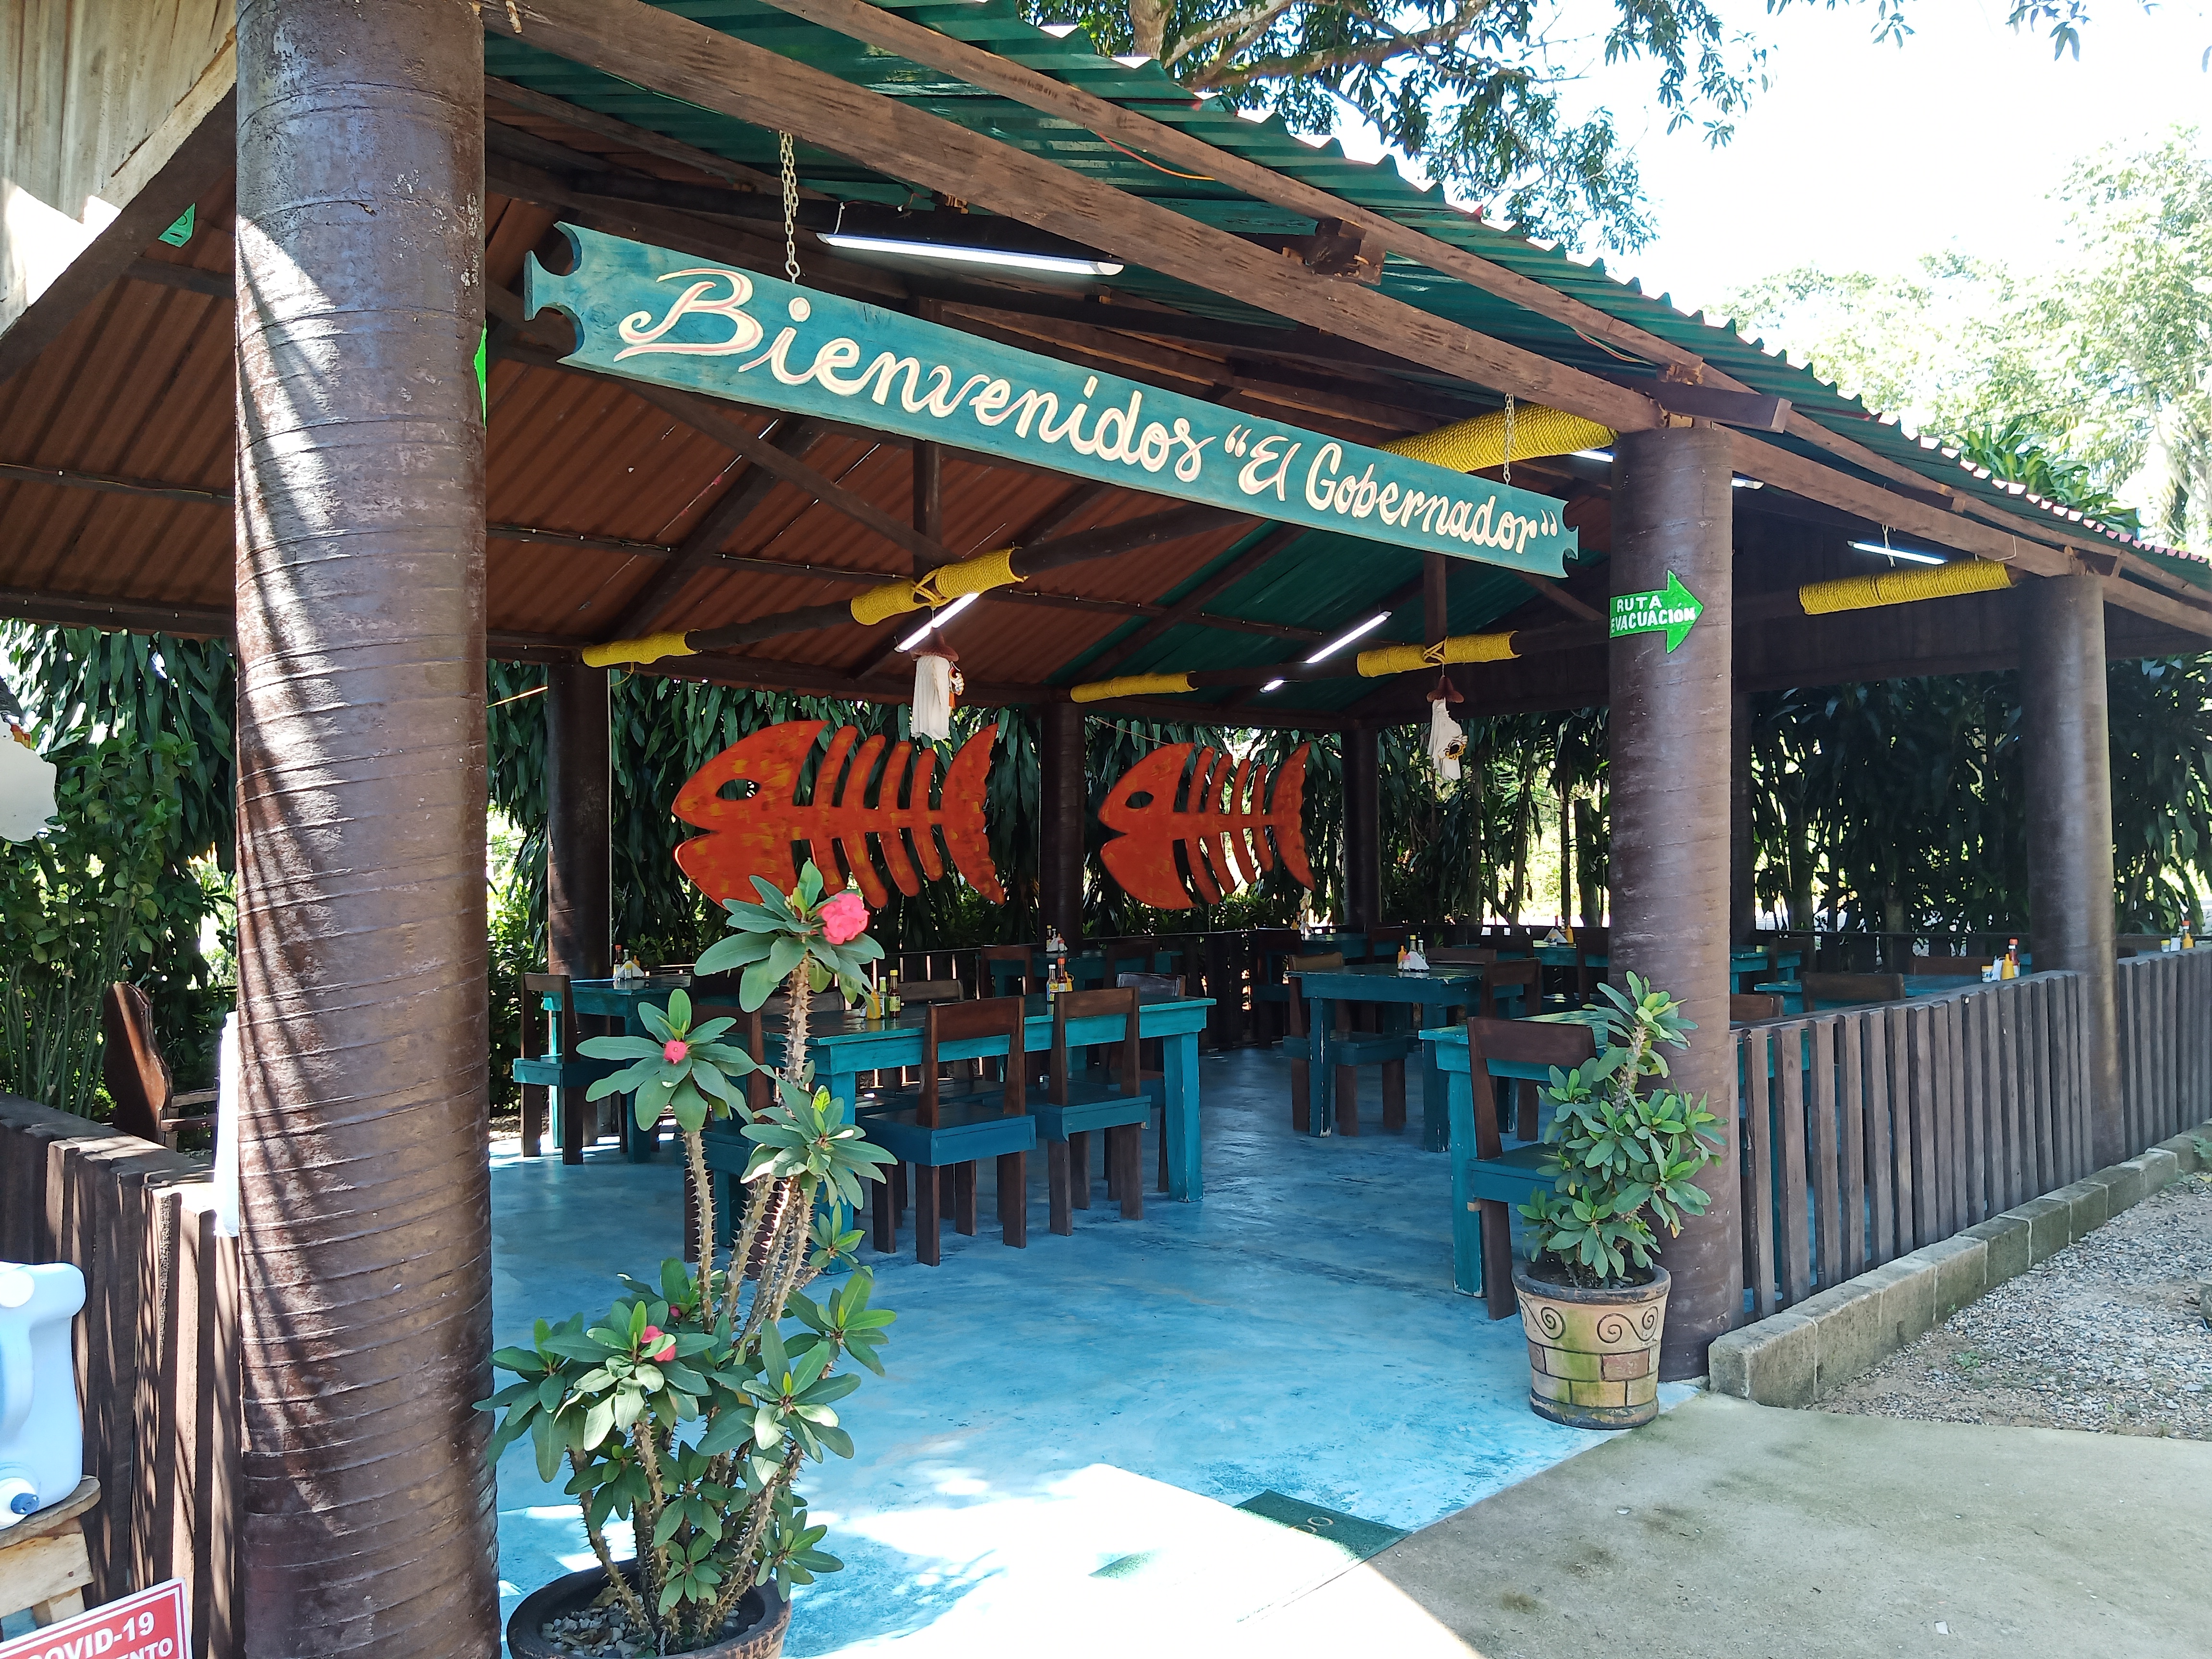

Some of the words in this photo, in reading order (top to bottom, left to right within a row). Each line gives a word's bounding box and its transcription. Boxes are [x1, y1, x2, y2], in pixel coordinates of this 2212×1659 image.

[611, 267, 1217, 483] Bienvenidos
[1611, 602, 1696, 633] EVACUACIÓN
[1617, 595, 1662, 613] RUTA
[27, 1611, 155, 1659] OVID-19
